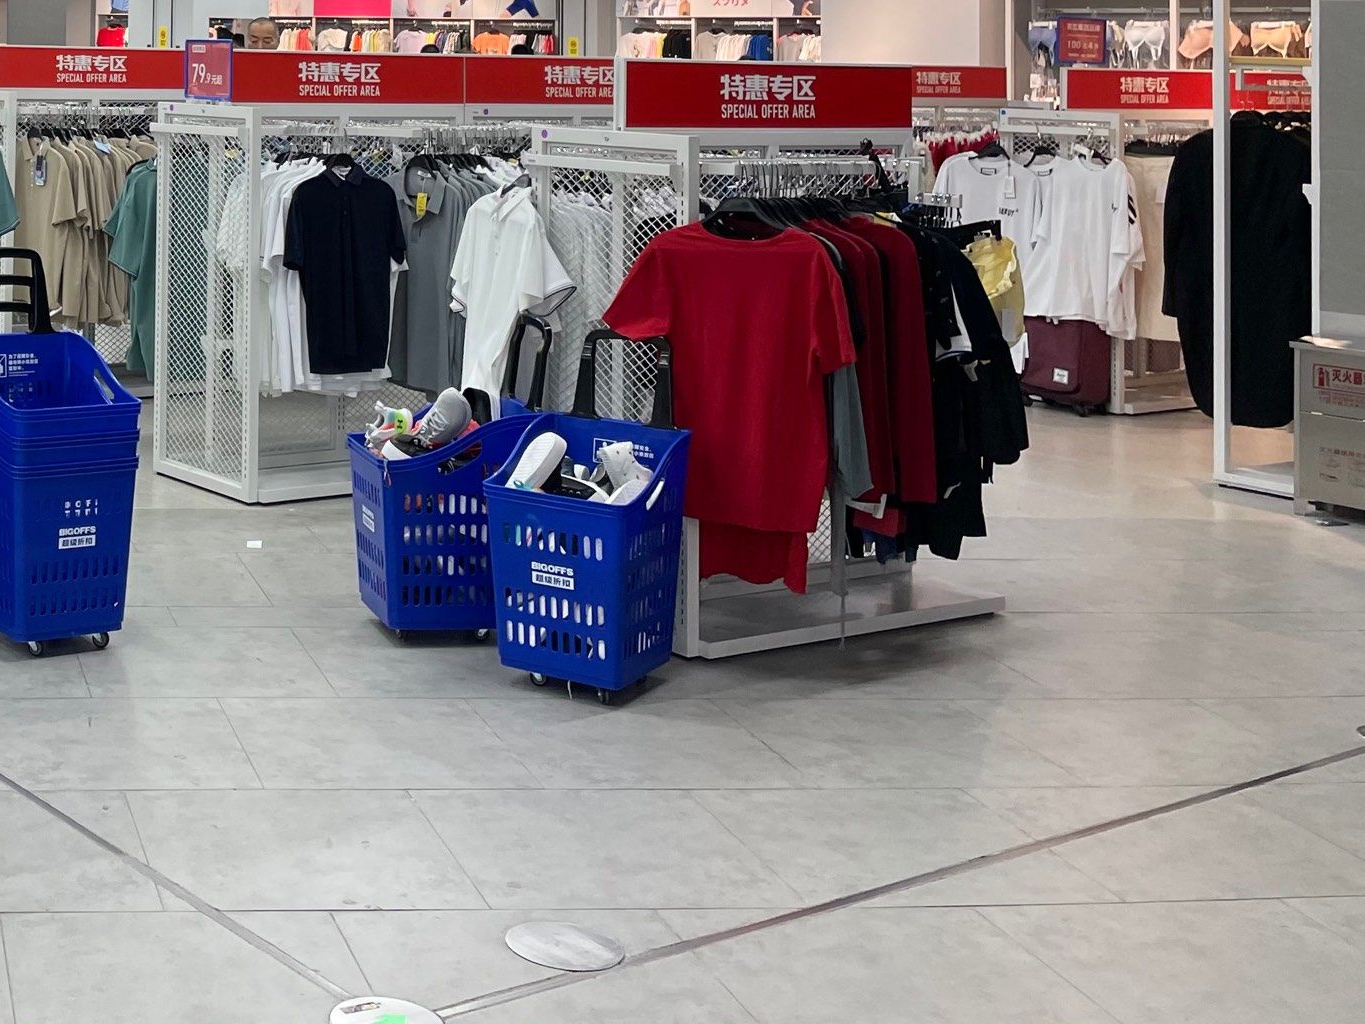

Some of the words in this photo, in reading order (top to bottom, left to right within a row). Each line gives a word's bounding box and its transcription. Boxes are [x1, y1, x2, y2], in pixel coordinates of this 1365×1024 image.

[55, 54, 128, 72] 特惠专区
[56, 73, 84, 83] SPECIAL
[86, 73, 107, 83] OFFER
[109, 73, 127, 83] AREA
[298, 60, 381, 84] 特惠专区
[544, 65, 614, 85] 特惠专区
[916, 71, 961, 85] 特惠专区
[299, 84, 331, 97] SPECIAL
[333, 84, 359, 97] OFFER
[362, 84, 381, 97] AREA
[545, 87, 573, 97] SPECIAL
[575, 87, 596, 97] OFFER
[720, 74, 816, 101] 特惠专区
[1120, 76, 1169, 93] 特惠专区
[721, 104, 759, 119] SPECIAL
[761, 104, 790, 119] OFFER
[792, 104, 816, 119] AREA
[59, 526, 96, 536] BIGOFFS
[531, 561, 574, 576] BIGOFFS
